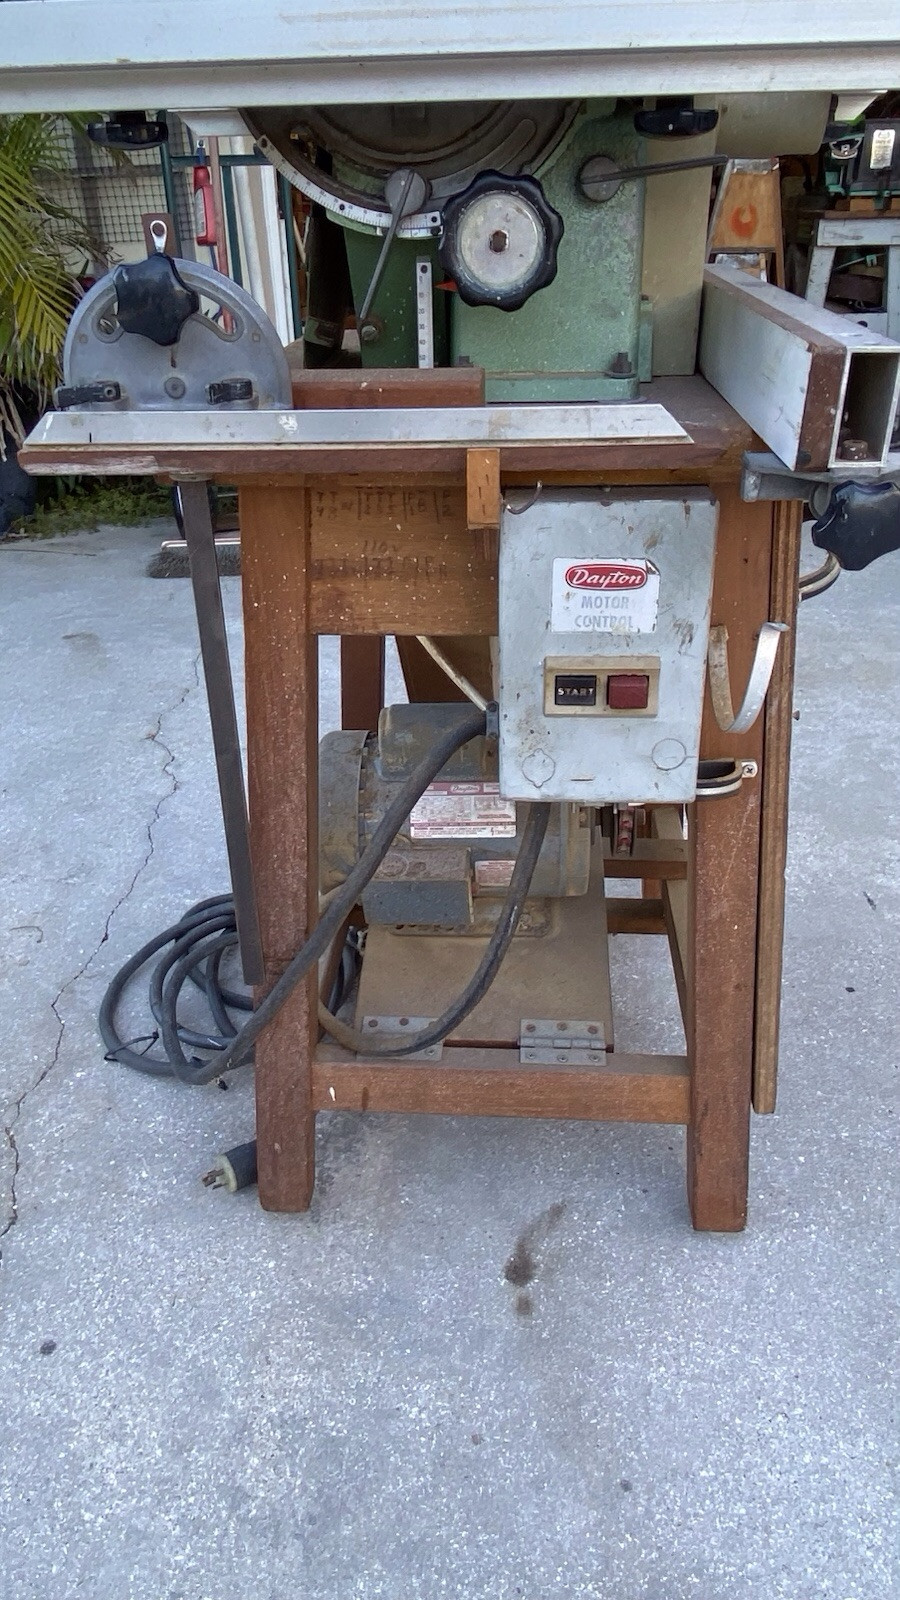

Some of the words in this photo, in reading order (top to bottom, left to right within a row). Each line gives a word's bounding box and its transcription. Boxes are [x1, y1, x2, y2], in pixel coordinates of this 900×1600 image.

[572, 568, 643, 589] Dayton
[580, 595, 630, 609] MOTOR
[574, 614, 634, 629] CONTROL
[557, 687, 595, 696] START
